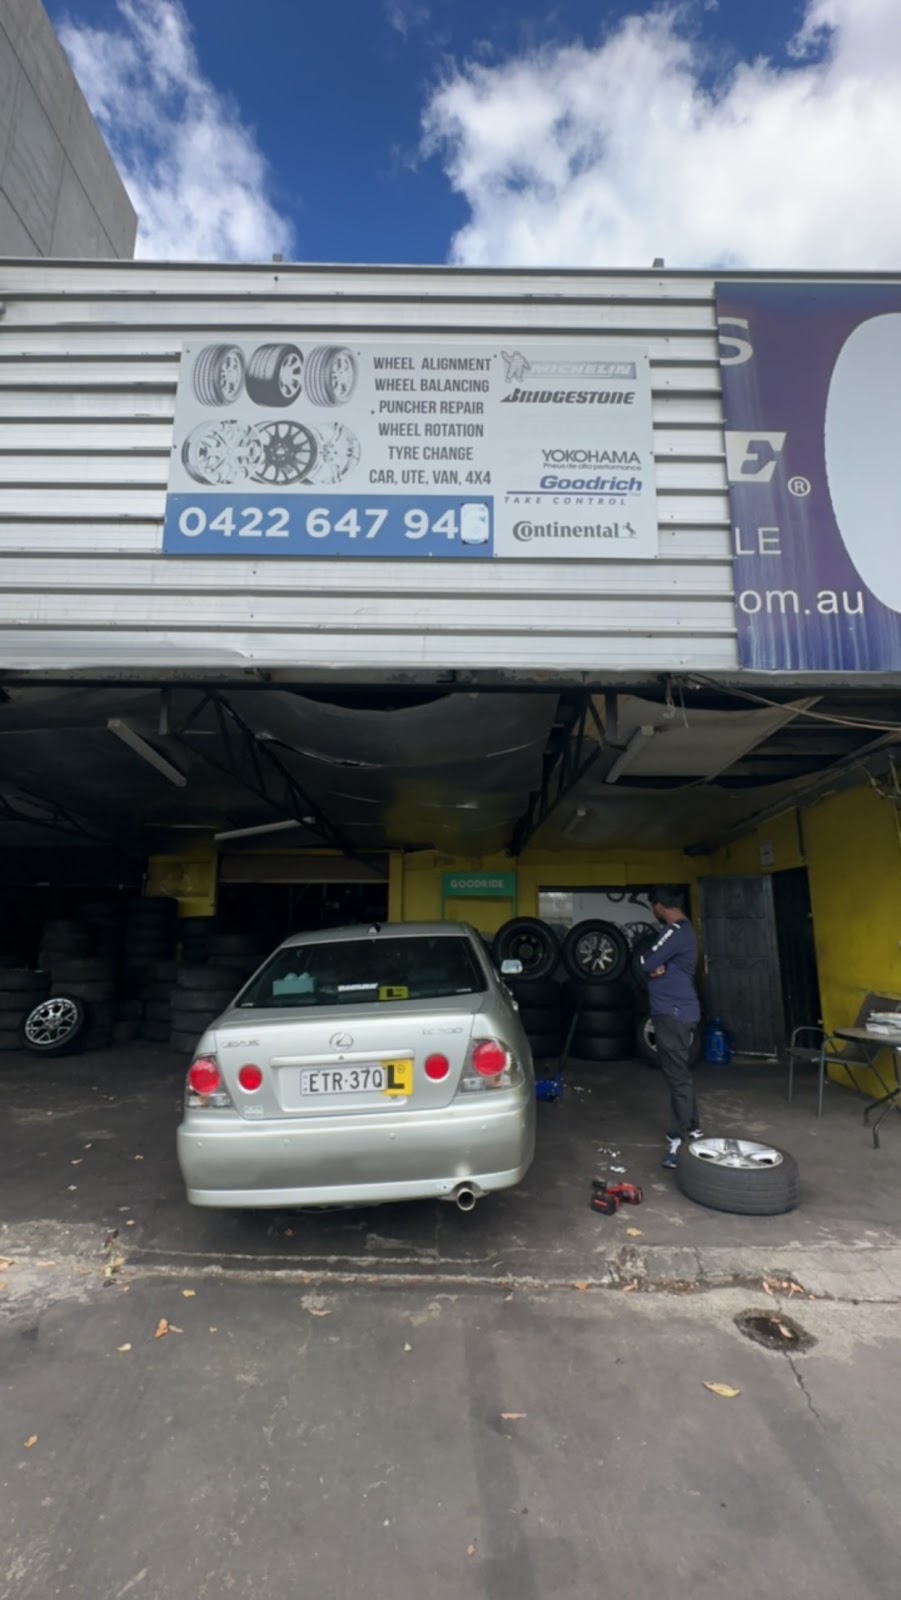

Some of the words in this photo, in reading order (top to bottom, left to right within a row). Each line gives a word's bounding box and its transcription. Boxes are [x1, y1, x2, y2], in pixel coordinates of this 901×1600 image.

[373, 356, 415, 370] WHEEL
[421, 357, 492, 371] ALIGNMENT
[527, 362, 633, 376] MICHELIN
[374, 378, 417, 392] WHEEL
[420, 378, 490, 392] BALANCING
[500, 387, 636, 405] BRIDGESTONE
[379, 400, 437, 414] PUNCHER
[440, 401, 484, 415] REPAIR
[378, 422, 422, 437] WHEEL
[424, 423, 484, 438] ROTATION
[388, 446, 420, 460] TYRE
[422, 446, 474, 461] CHANGE
[541, 449, 642, 464] YOKOHAMA
[369, 469, 398, 485] CAR,
[401, 470, 429, 486] UTE,
[432, 470, 462, 486] VAN,
[465, 470, 492, 486] 4X4
[539, 475, 643, 492] Goodrich
[504, 496, 542, 505] TAKE
[552, 497, 626, 506] CONTROL
[178, 506, 290, 538] 0422
[305, 507, 389, 539] 647
[512, 520, 620, 542] Continental
[735, 526, 781, 555] LE
[738, 590, 865, 616] om.au
[450, 879, 505, 889] GOODRIDE
[387, 1064, 405, 1090] L
